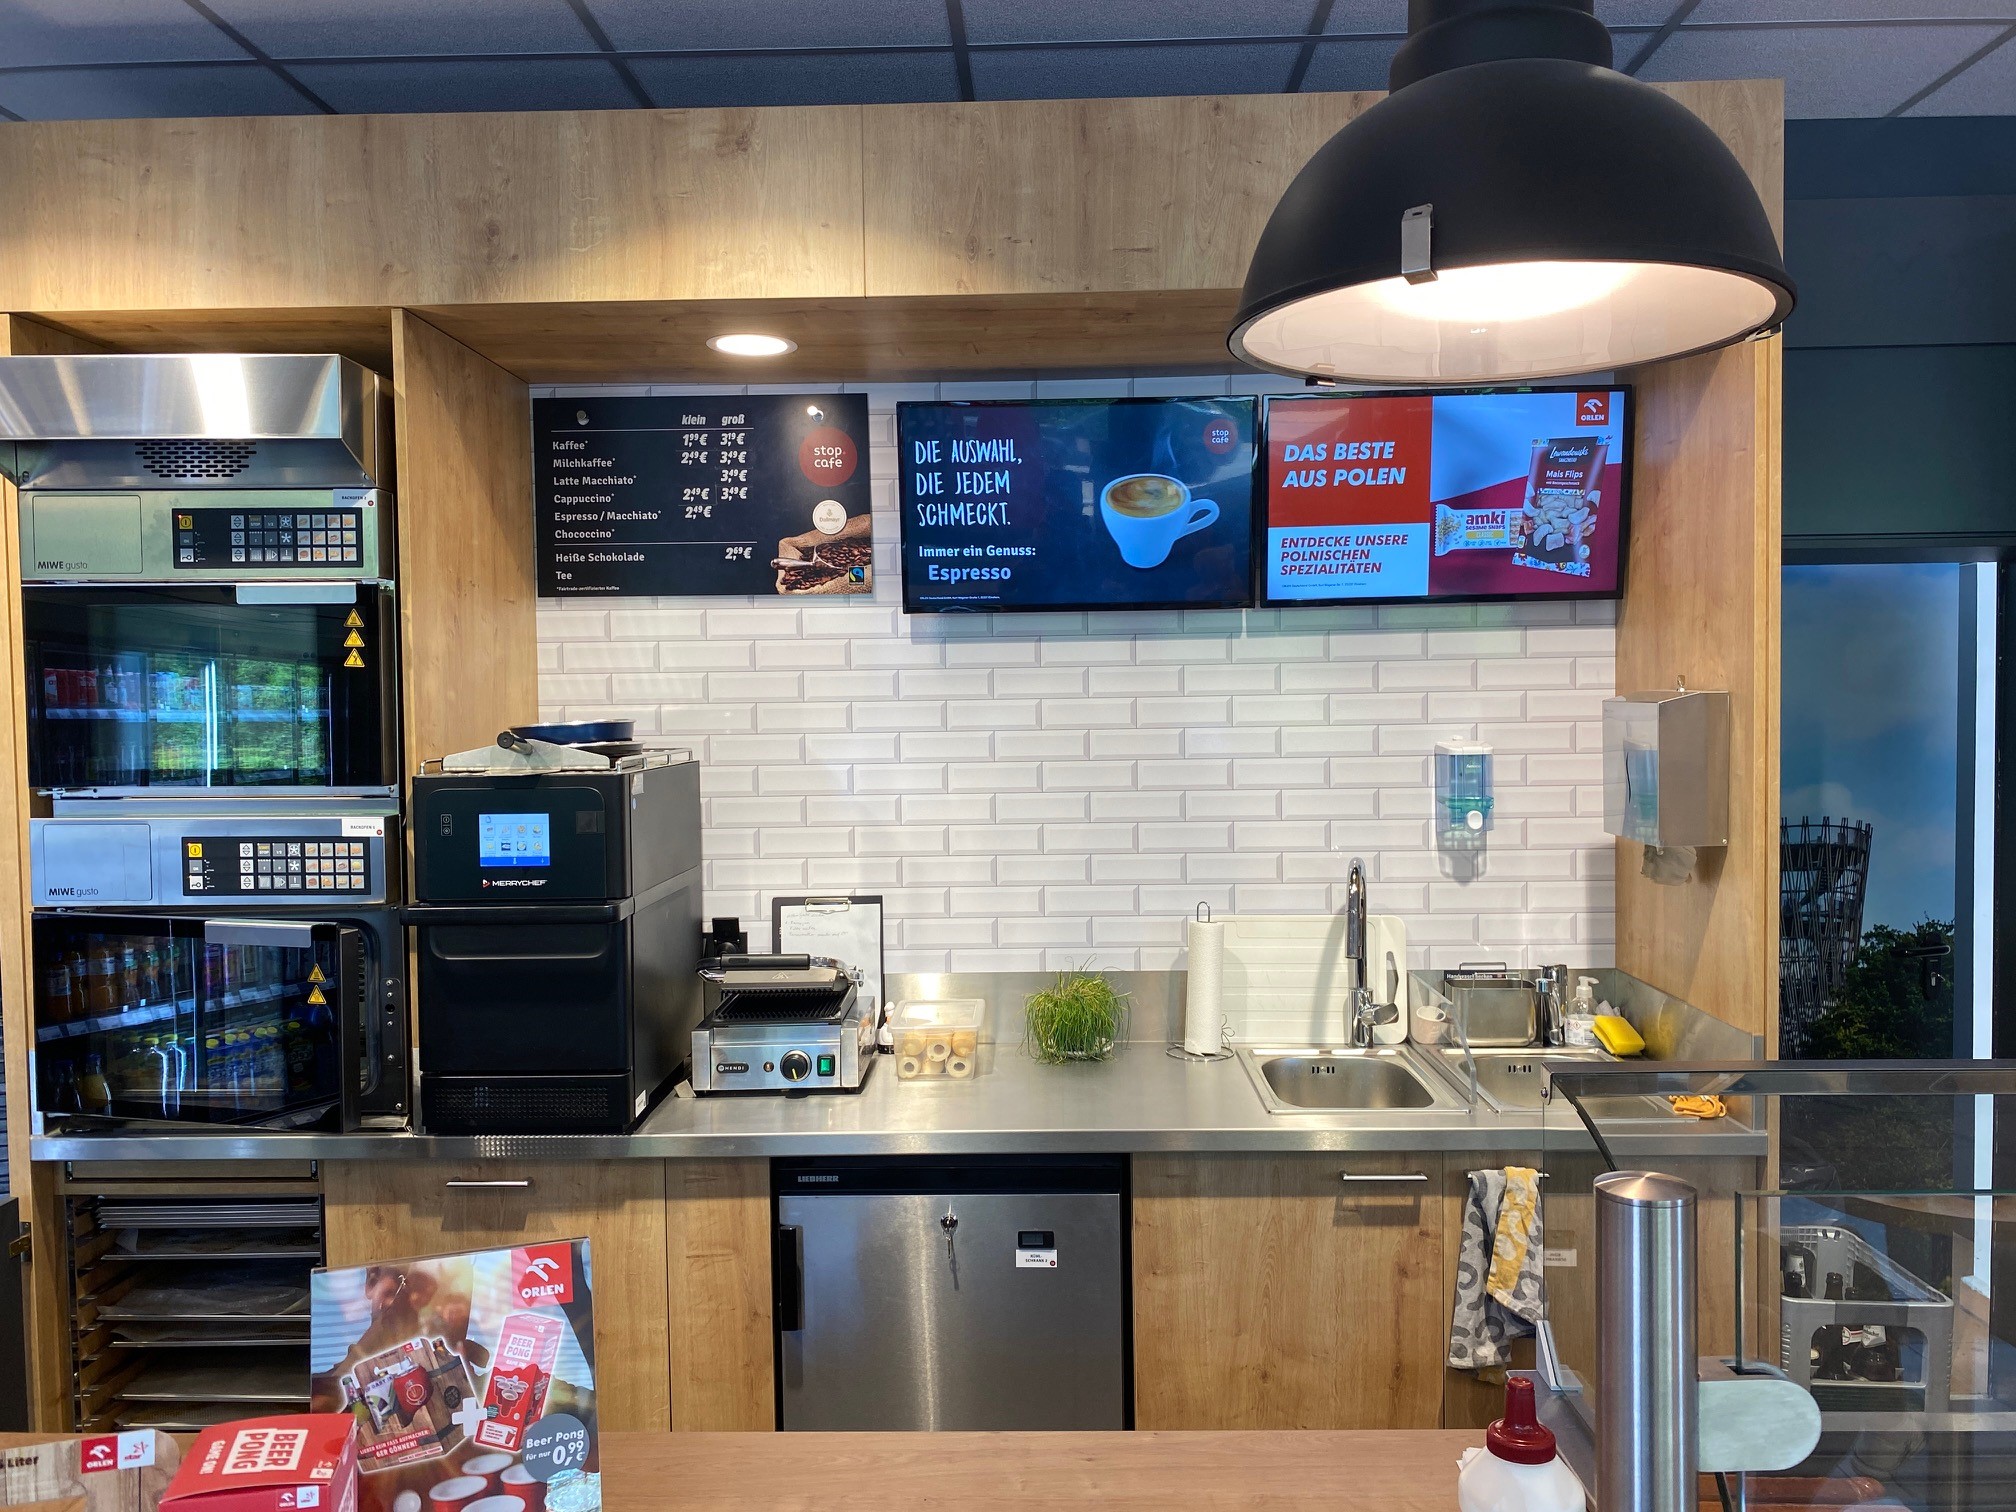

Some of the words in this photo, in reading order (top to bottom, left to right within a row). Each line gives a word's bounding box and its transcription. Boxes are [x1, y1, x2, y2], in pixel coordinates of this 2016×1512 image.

[682, 414, 706, 425] klein
[722, 414, 745, 426] groß
[814, 446, 842, 458] stop
[915, 440, 942, 464] DIE
[952, 439, 1022, 464] AUSWAHL,
[1284, 444, 1328, 462] DAS
[1334, 442, 1395, 460] BESTE
[814, 458, 842, 469] cafe
[554, 476, 579, 485] Latte
[1282, 470, 1327, 488] AUS
[1334, 467, 1406, 486] POLEN
[1565, 470, 1583, 479] Flips
[916, 472, 944, 496] DIE
[955, 470, 1010, 495] JEDEM
[554, 512, 598, 522] Espresso
[600, 511, 605, 521] /
[917, 502, 1010, 526] SCHMECKT.
[1466, 511, 1506, 525] amki
[1281, 536, 1350, 548] ENTDECKE
[1355, 534, 1408, 546] UNSERE
[556, 553, 586, 562] Heiße
[588, 552, 645, 562] Schokolade
[919, 546, 960, 557] Immer
[963, 545, 983, 556] ein
[986, 545, 1036, 556] Genuss:
[1281, 549, 1370, 562] POLNISCHEN
[38, 561, 64, 569] MIWE
[66, 562, 88, 571] gusto
[1280, 560, 1382, 575] SPEZIALITÄTEN
[556, 571, 572, 580] Tee
[928, 564, 1011, 584] Espresso
[76, 888, 98, 897] gusto
[522, 1284, 564, 1298] ORLEN
[510, 1336, 532, 1348] BEER
[506, 1346, 530, 1358] PONG
[387, 1439, 398, 1447] FASS
[526, 1436, 552, 1449] Beer
[556, 1430, 584, 1442] Pong
[232, 1432, 268, 1469] PONG
[264, 1434, 298, 1466] BEER
[376, 1449, 388, 1457] 6ER
[389, 1440, 417, 1454] GÖNNEN!
[8, 1456, 39, 1468] Liter
[86, 1459, 114, 1468] ORLEN
